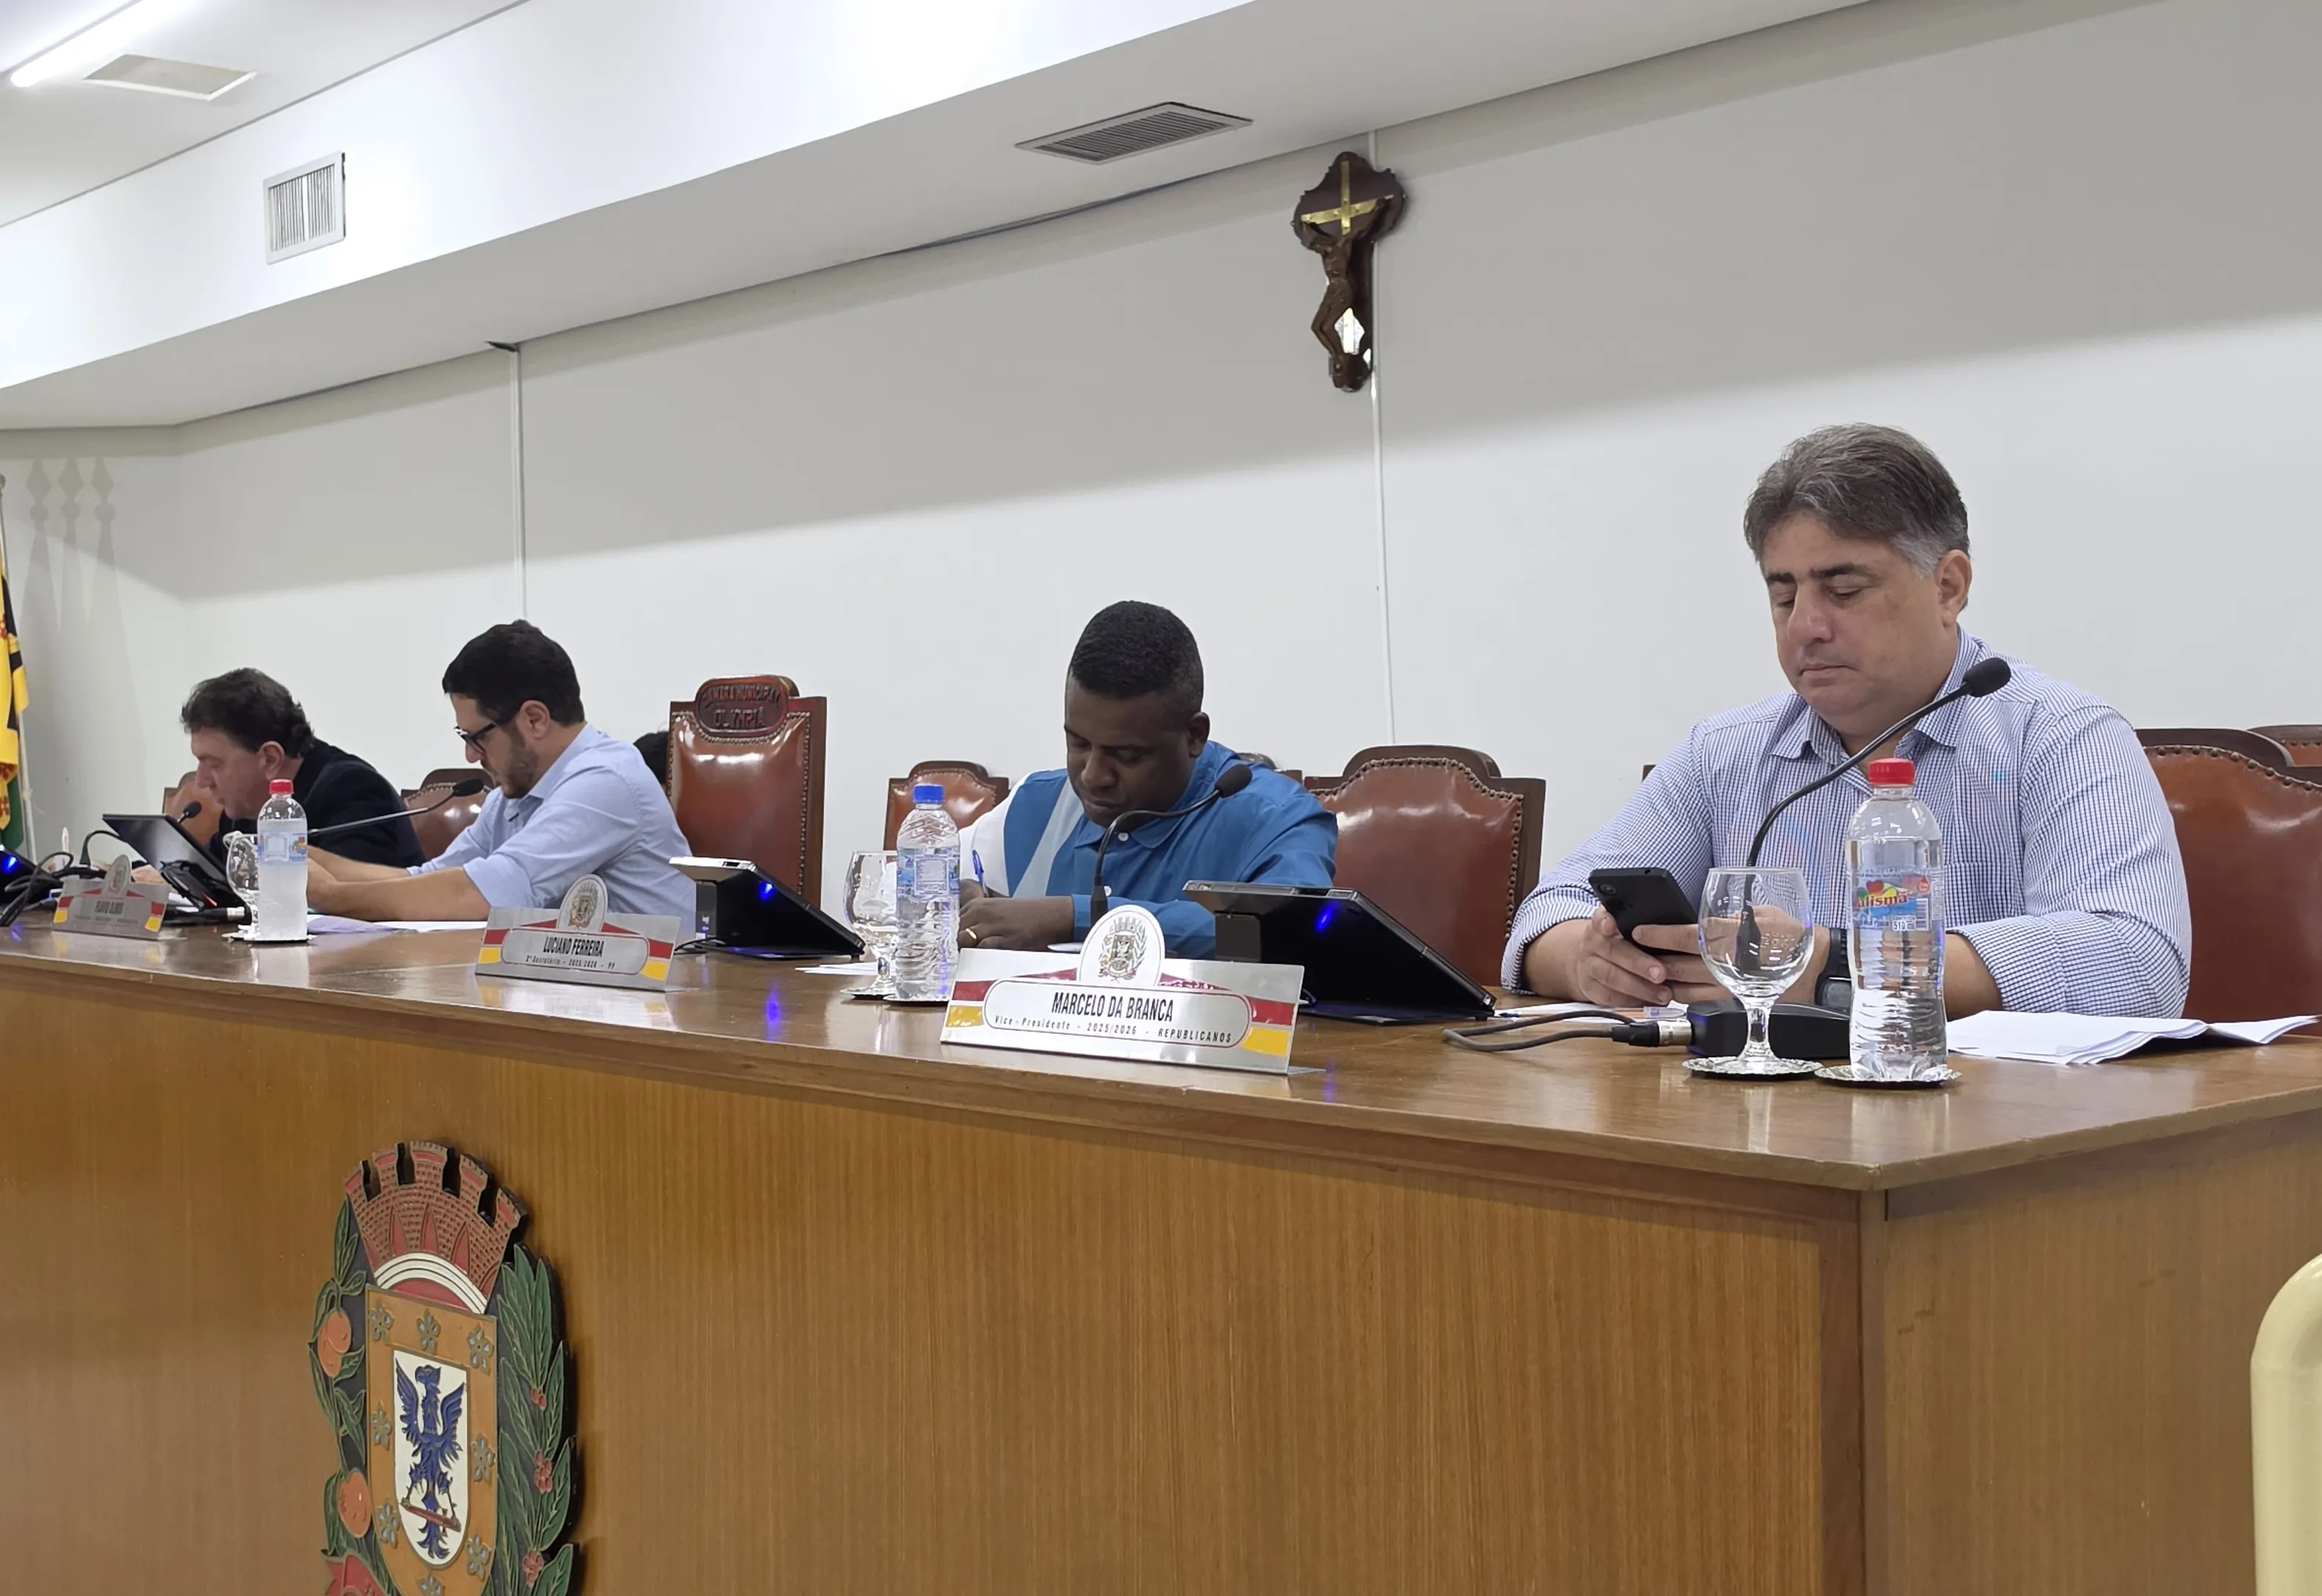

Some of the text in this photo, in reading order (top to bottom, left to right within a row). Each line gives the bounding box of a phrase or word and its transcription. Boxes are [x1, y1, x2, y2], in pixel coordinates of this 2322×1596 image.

[543, 936, 604, 958] LUCIANO FERREIRA
[1052, 992, 1175, 1022] MARCELO DA BRANCA
[1087, 1022, 1136, 1035] 2025/2026
[1158, 1028, 1233, 1043] REPUBLICANOS
